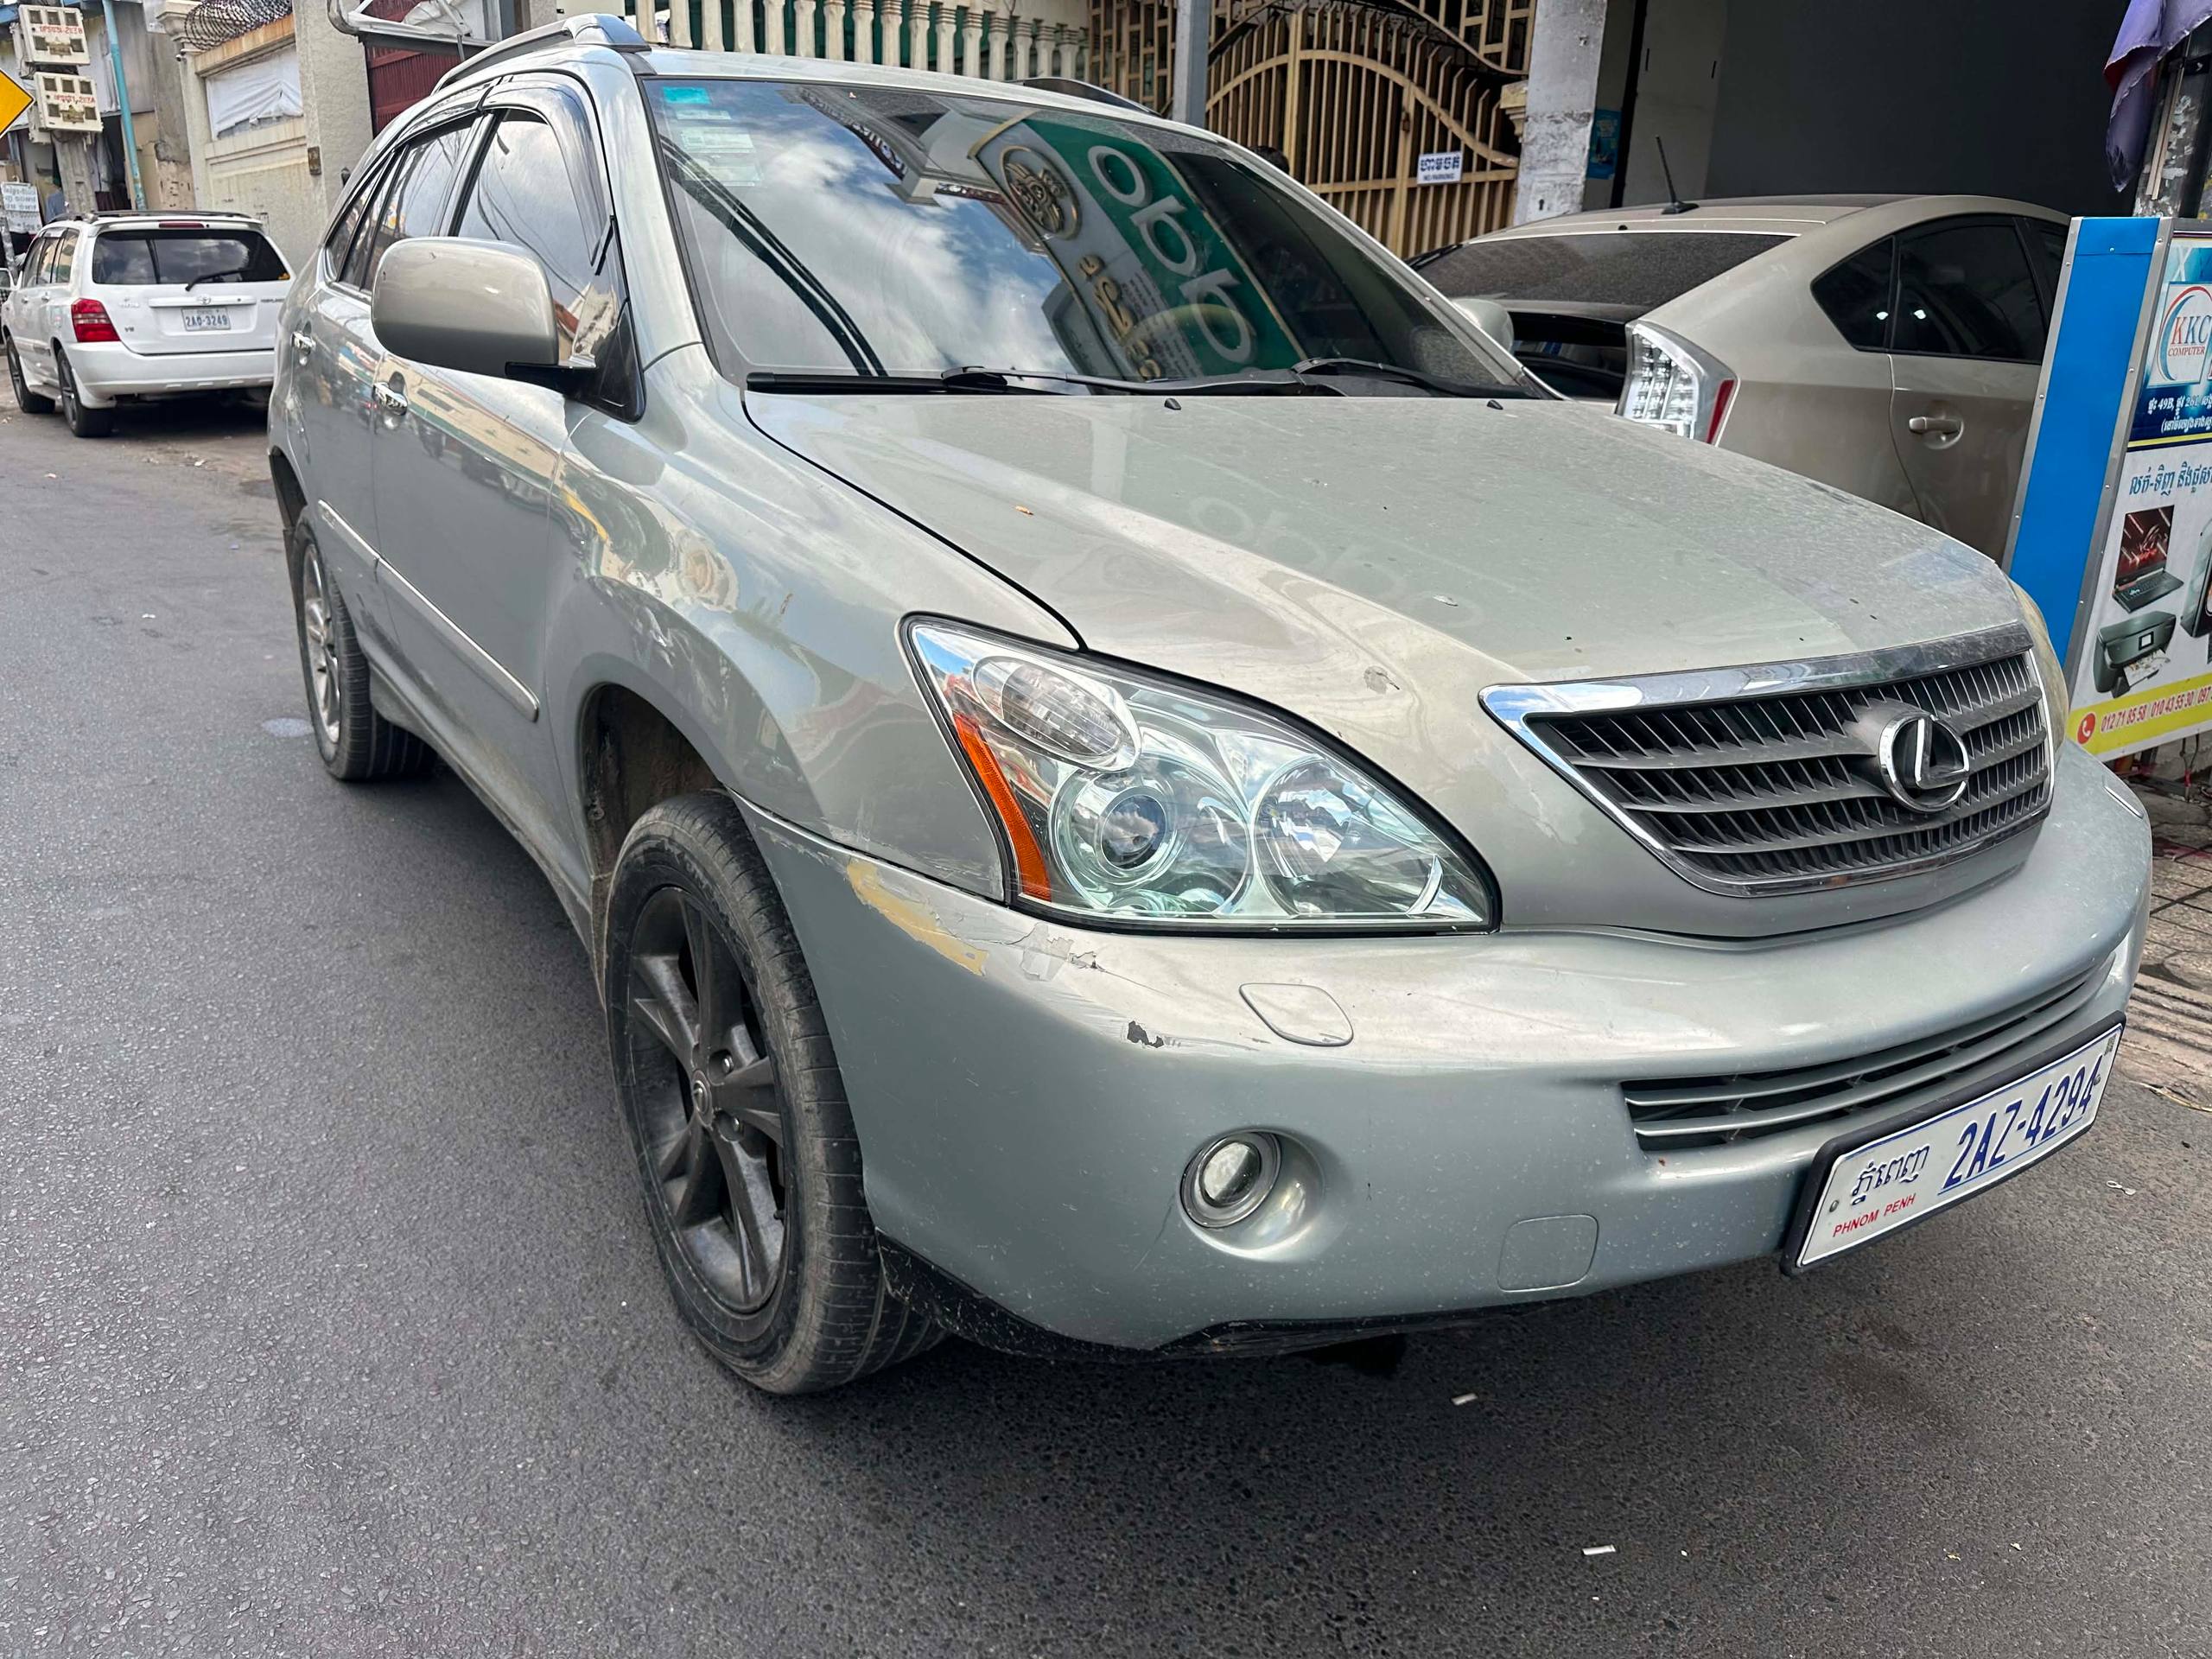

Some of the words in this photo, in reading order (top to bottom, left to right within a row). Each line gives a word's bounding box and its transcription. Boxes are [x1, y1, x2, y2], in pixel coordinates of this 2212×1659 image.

[2168, 346, 2205, 357] COMPUTER
[2171, 315, 2211, 345] KKC
[1942, 1053, 2103, 1191] 2AZ-4294
[1850, 1145, 1930, 1206] ភ្នំពេញ
[1832, 1209, 1879, 1237] PHNOM
[1883, 1192, 1916, 1217] PENH
